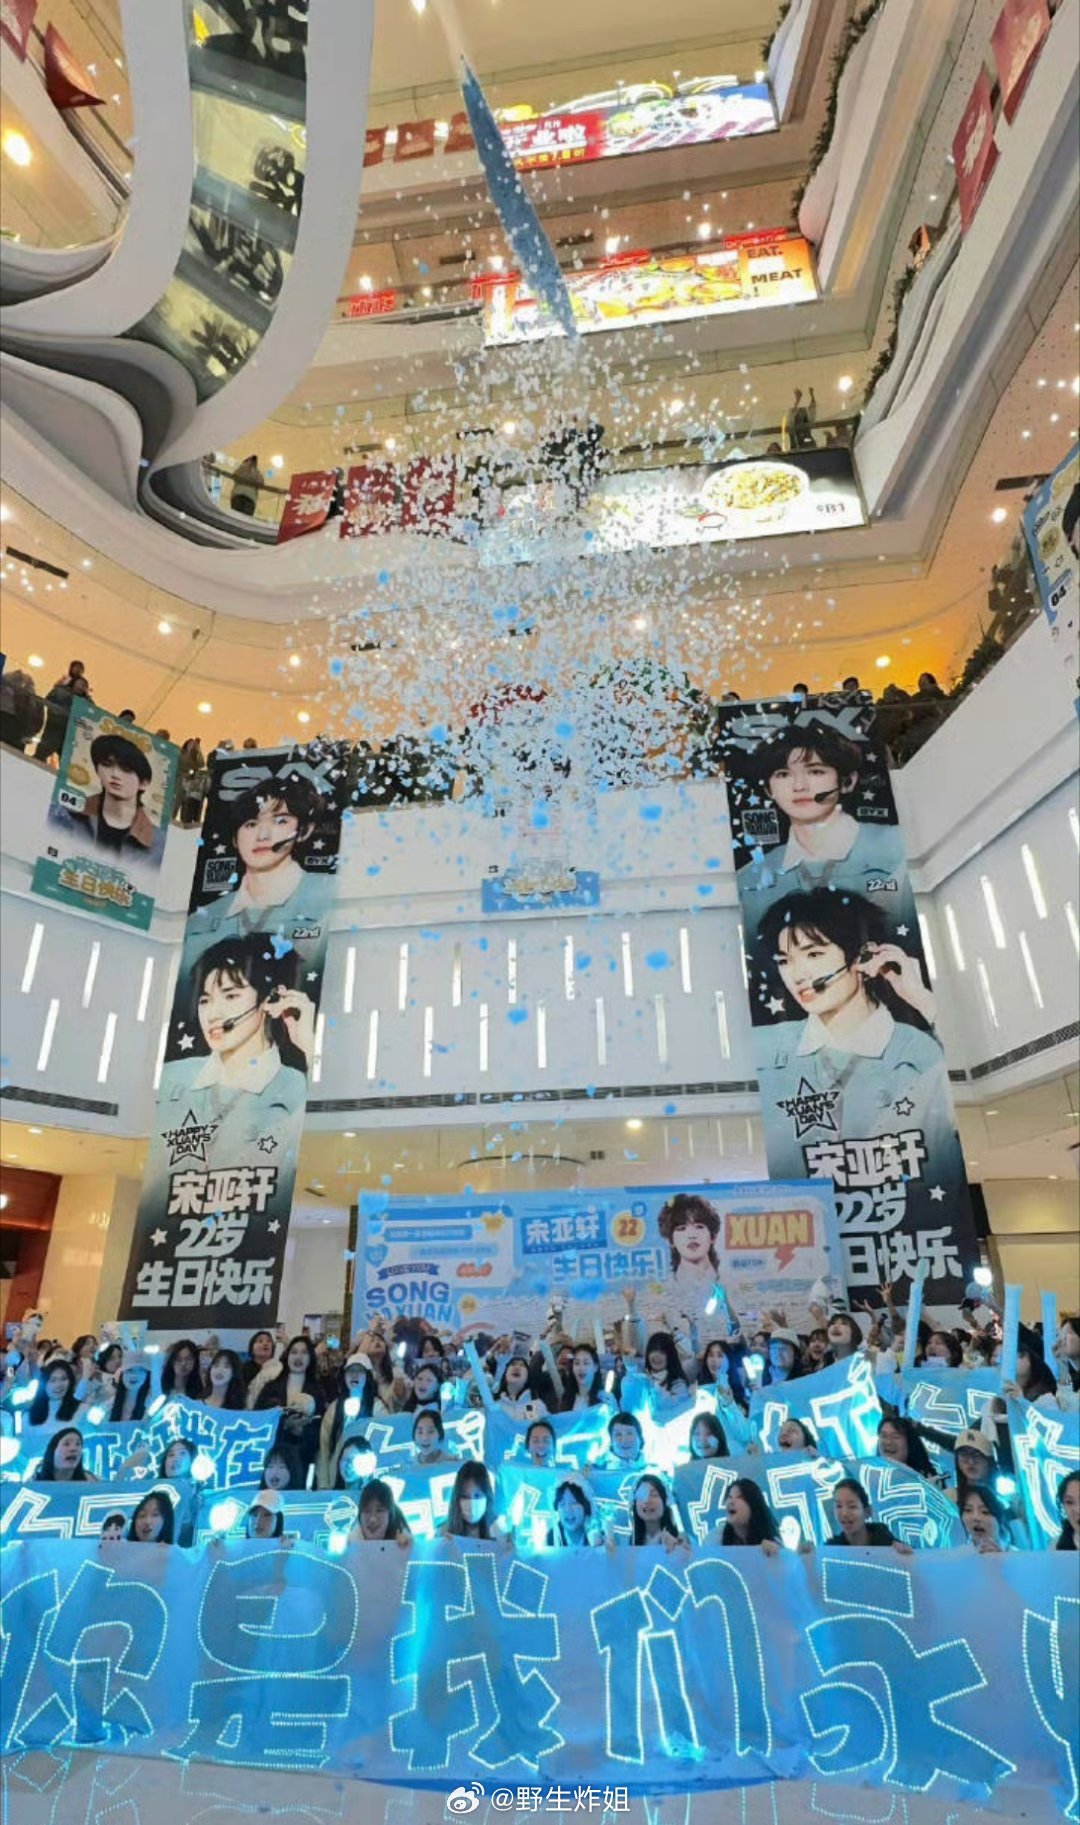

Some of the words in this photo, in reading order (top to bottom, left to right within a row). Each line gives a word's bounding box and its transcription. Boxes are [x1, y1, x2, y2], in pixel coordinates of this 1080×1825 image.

[746, 244, 784, 259] EAT.
[751, 267, 803, 284] MEAT
[867, 878, 897, 892] 22nd
[293, 926, 321, 939] 22nd
[784, 1091, 831, 1108] HAPPY
[786, 1101, 835, 1117] XUAN'S
[800, 1111, 824, 1125] DAY
[168, 1124, 209, 1138] HAPPY
[176, 1143, 199, 1154] DAY
[804, 1129, 926, 1187] 宋亚轩
[167, 1166, 276, 1215] 宋亚轩
[526, 1204, 600, 1245] 宋亚轩
[618, 1218, 638, 1238] 22
[728, 1212, 810, 1247] XUAN
[173, 1212, 250, 1258] 22岁
[839, 1226, 964, 1287] 日快乐
[131, 1257, 277, 1307] 生日快乐
[366, 1280, 450, 1308] SONG
